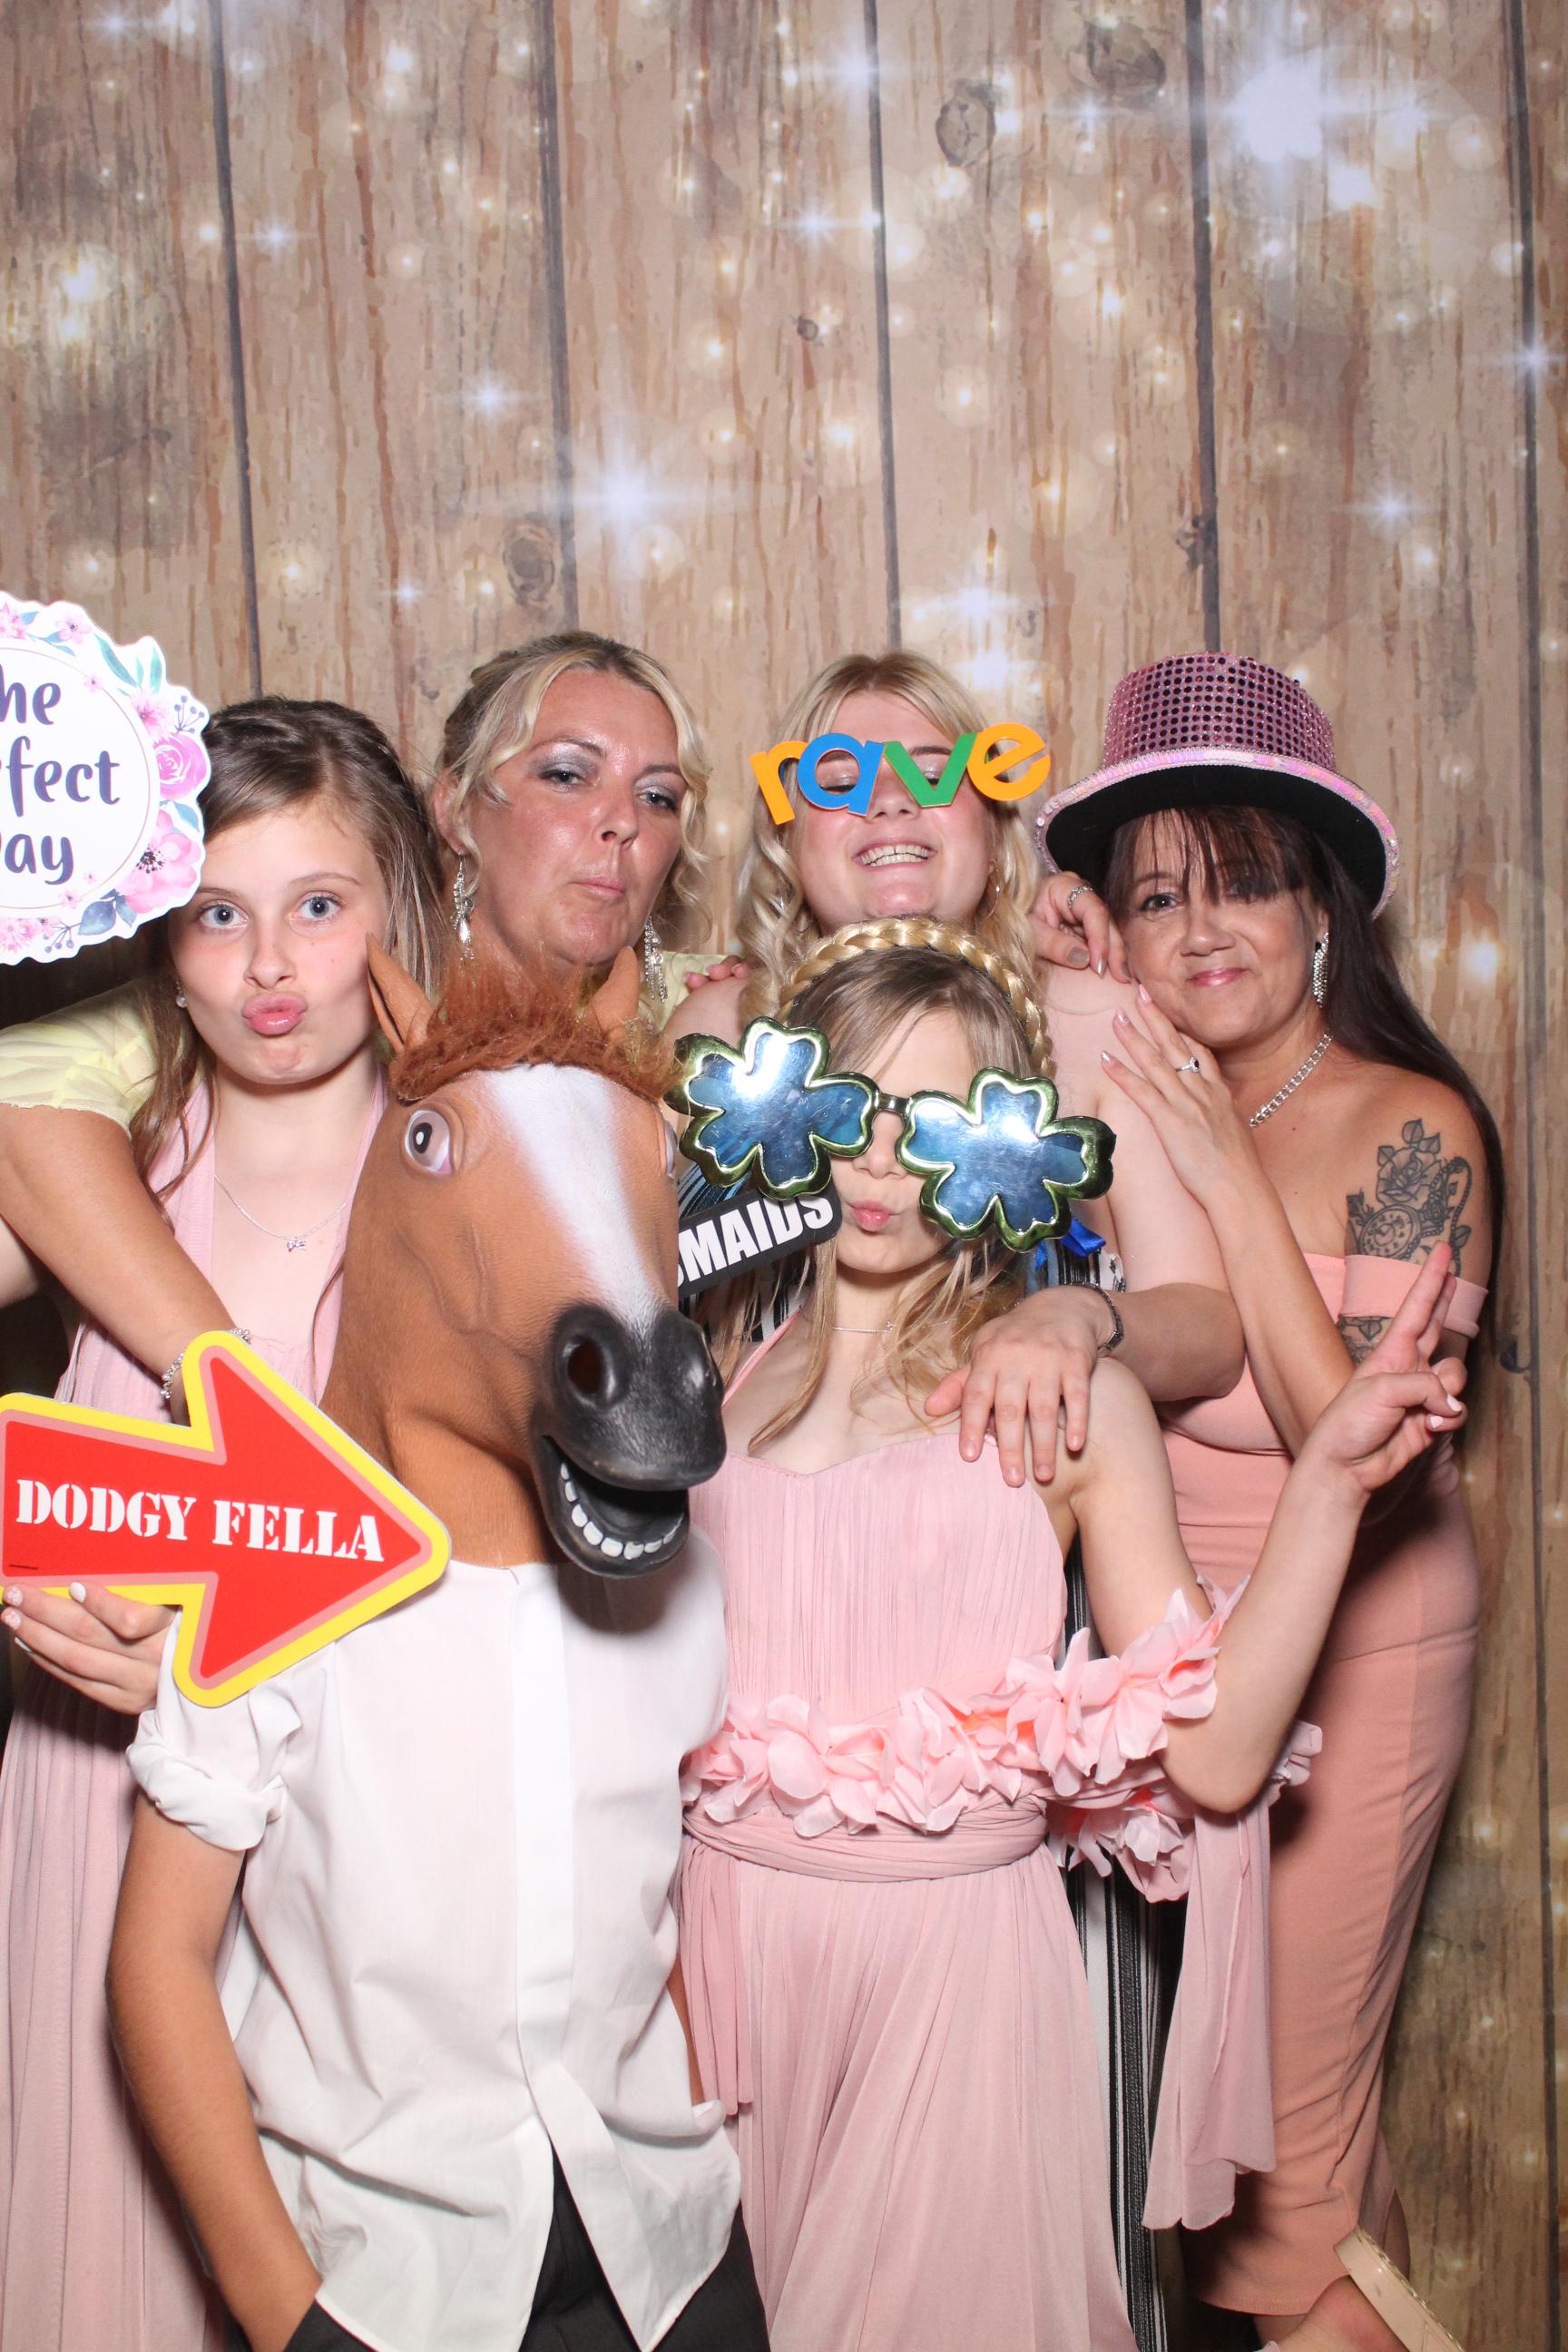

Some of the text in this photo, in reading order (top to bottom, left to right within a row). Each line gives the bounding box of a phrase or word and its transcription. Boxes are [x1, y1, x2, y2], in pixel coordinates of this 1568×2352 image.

[0, 736, 120, 817] fect
[749, 722, 1051, 825] rave
[0, 834, 74, 885] ay
[678, 1198, 833, 1287] MAIDS
[16, 1479, 384, 1563] DODGY FELLA
